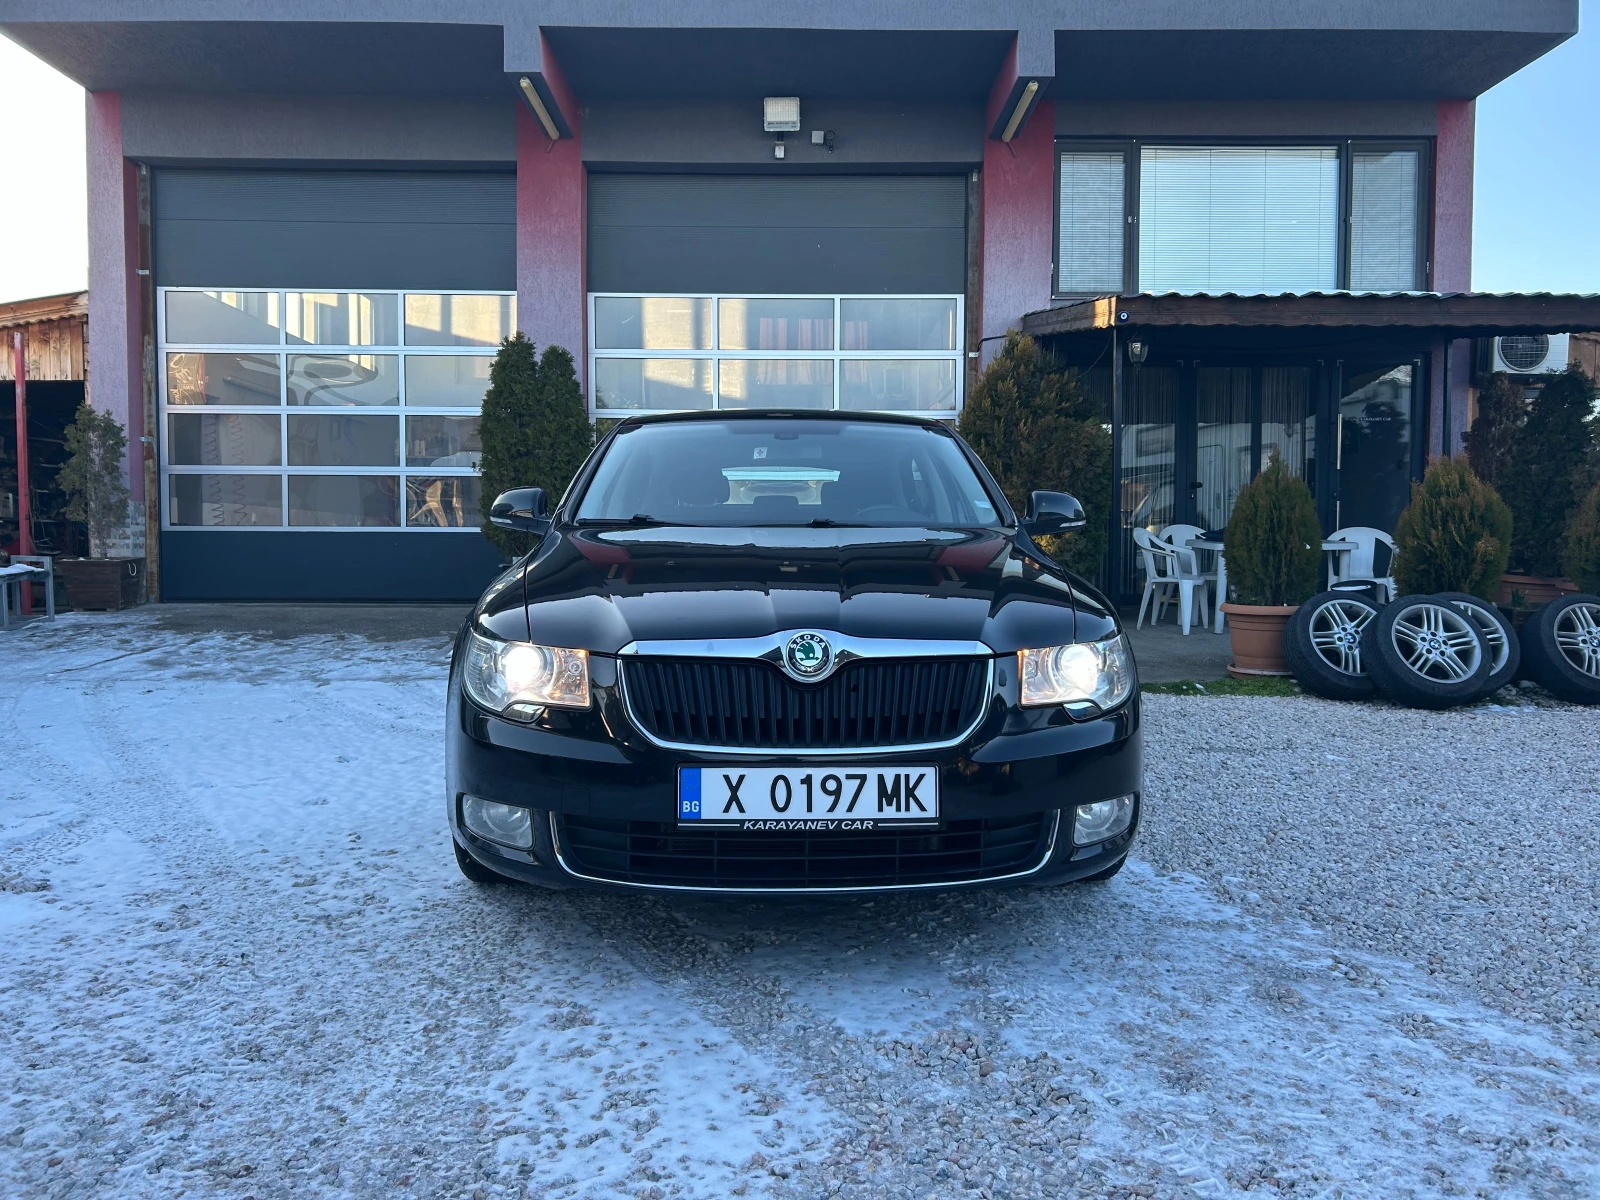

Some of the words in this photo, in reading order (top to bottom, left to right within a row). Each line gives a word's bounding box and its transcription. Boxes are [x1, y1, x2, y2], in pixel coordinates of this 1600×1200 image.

[722, 774, 747, 814] X
[770, 773, 868, 813] 0197
[877, 773, 928, 813] MK
[682, 800, 700, 813] BG
[743, 820, 838, 830] KARAYANEV
[841, 820, 874, 830] CAR
